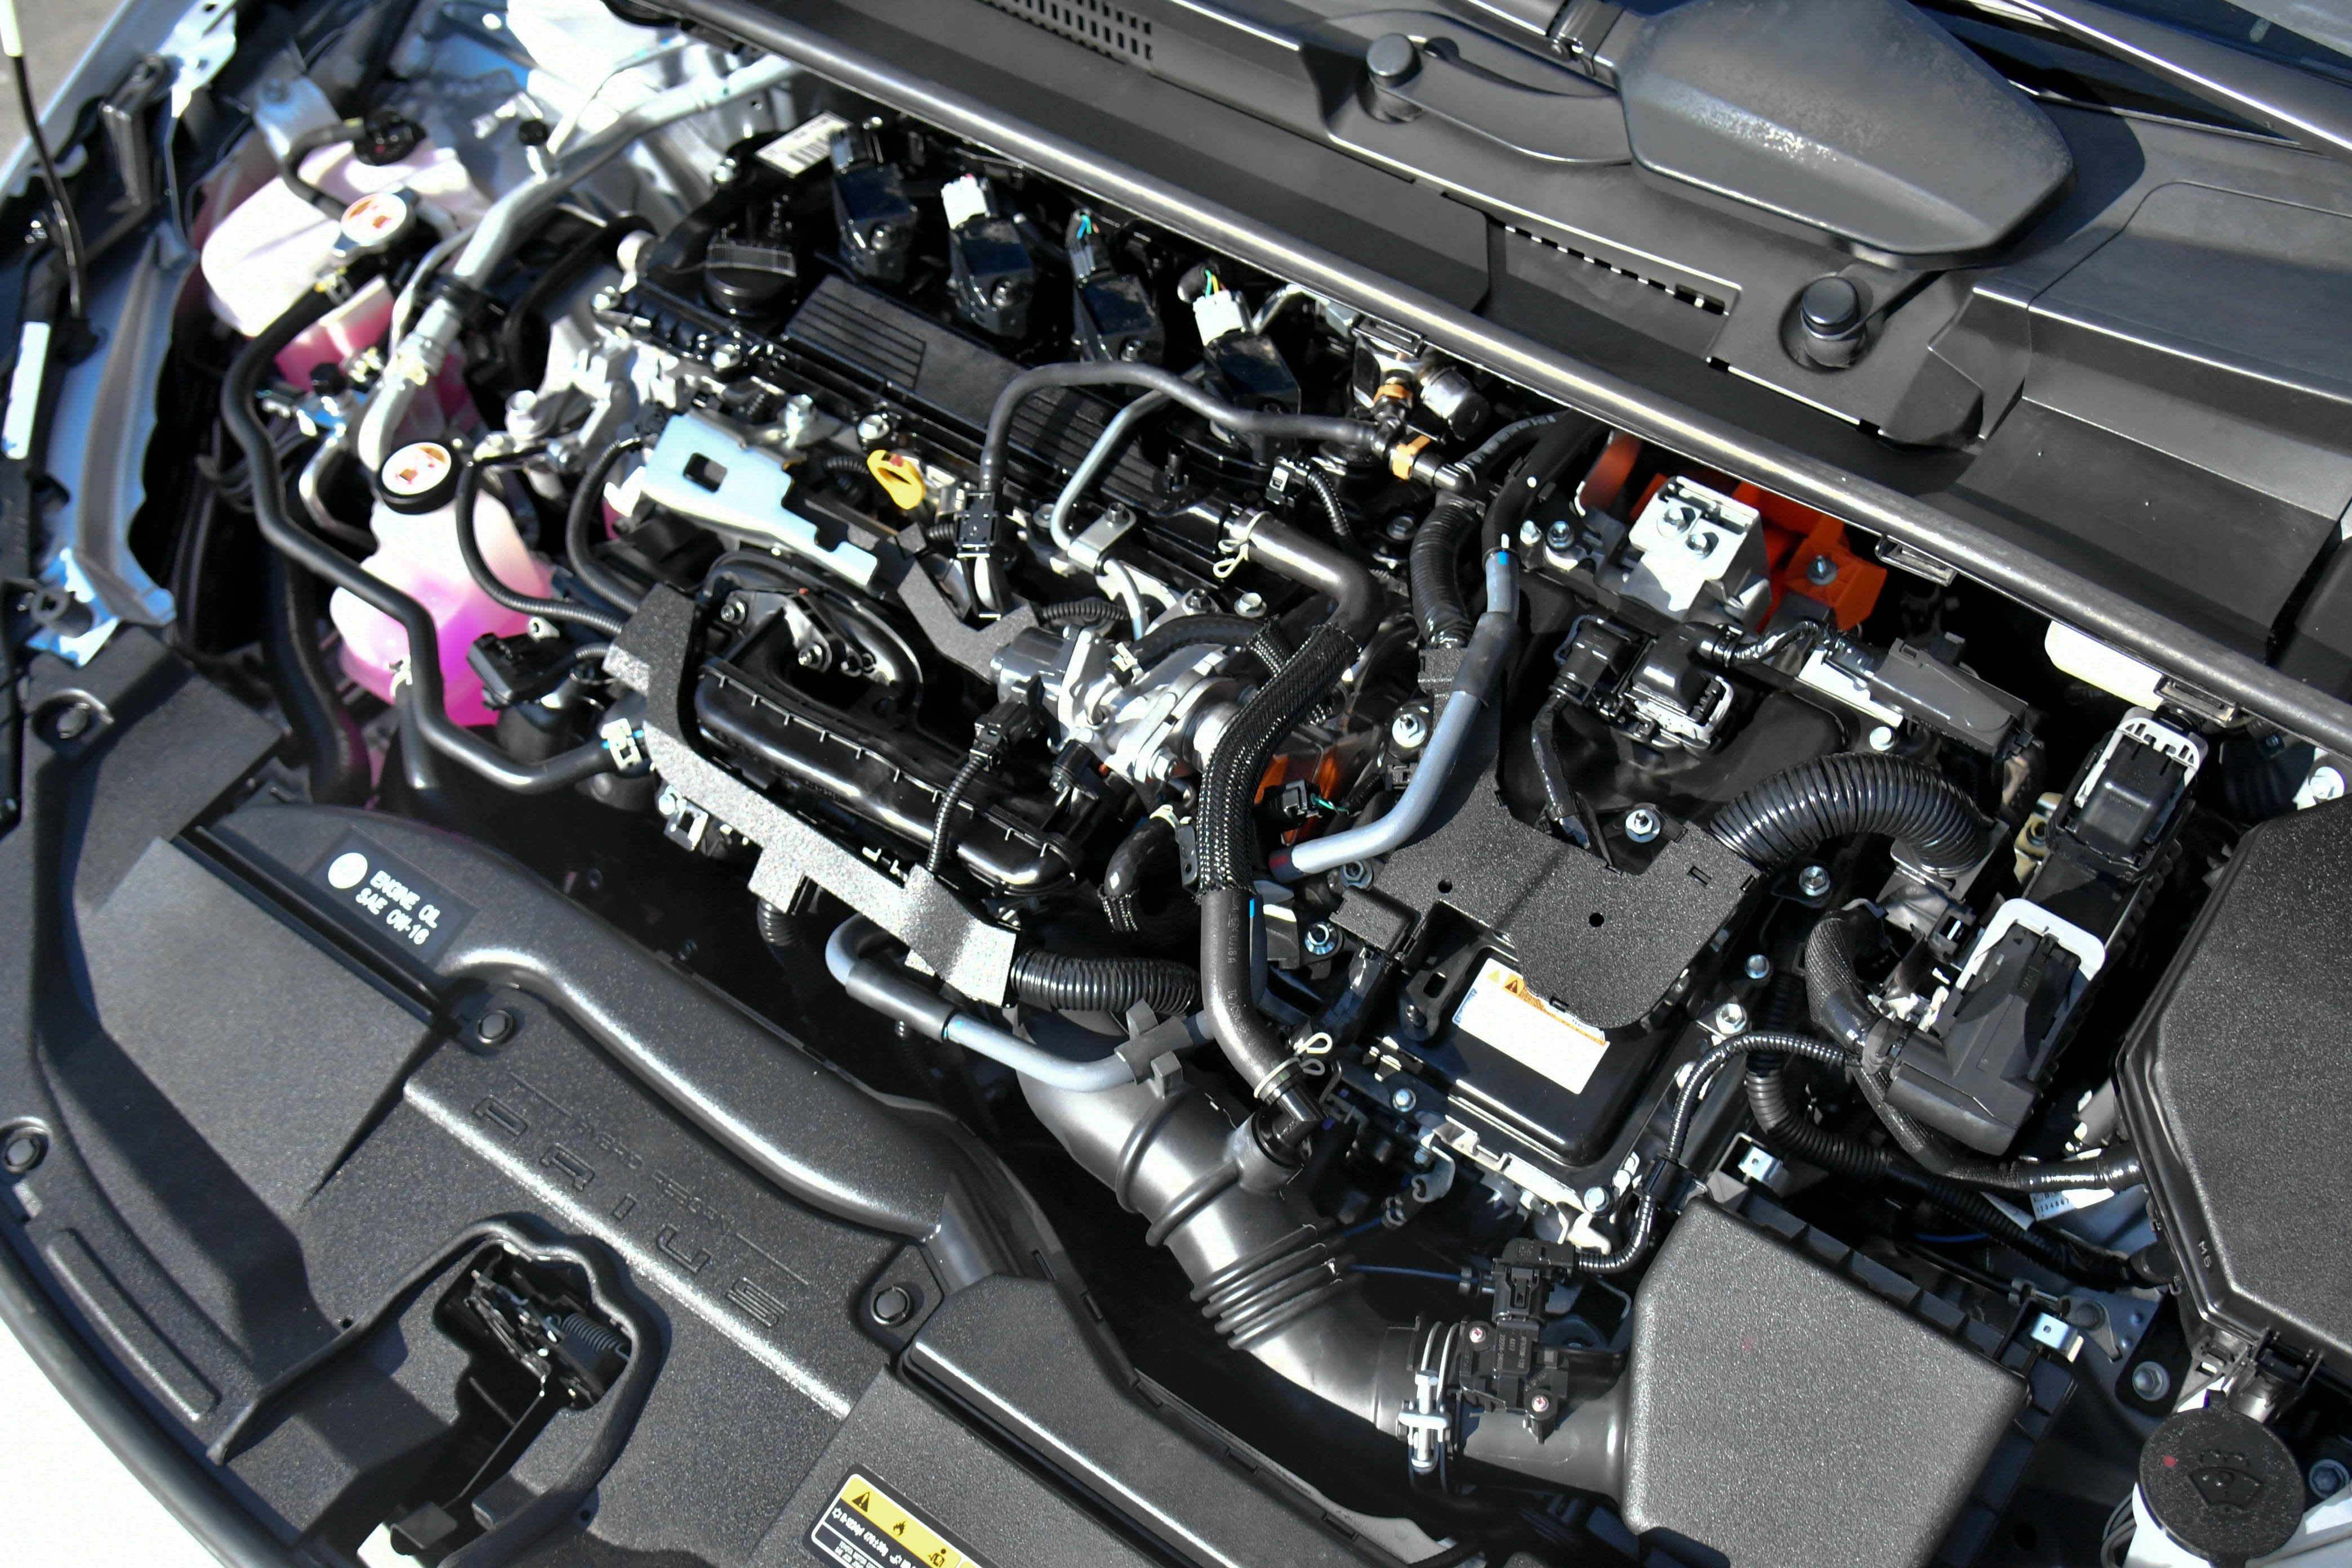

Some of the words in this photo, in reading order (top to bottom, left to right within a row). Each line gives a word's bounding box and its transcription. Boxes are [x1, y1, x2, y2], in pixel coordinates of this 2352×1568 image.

[355, 888, 388, 915] SAE
[386, 909, 429, 945] 0W-16
[370, 870, 420, 911] ENGINE
[418, 904, 440, 929] OIL
[474, 1095, 788, 1329] PRIUS
[839, 1540, 853, 1555] TOYOTA
[853, 1552, 867, 1565] MOTOR
